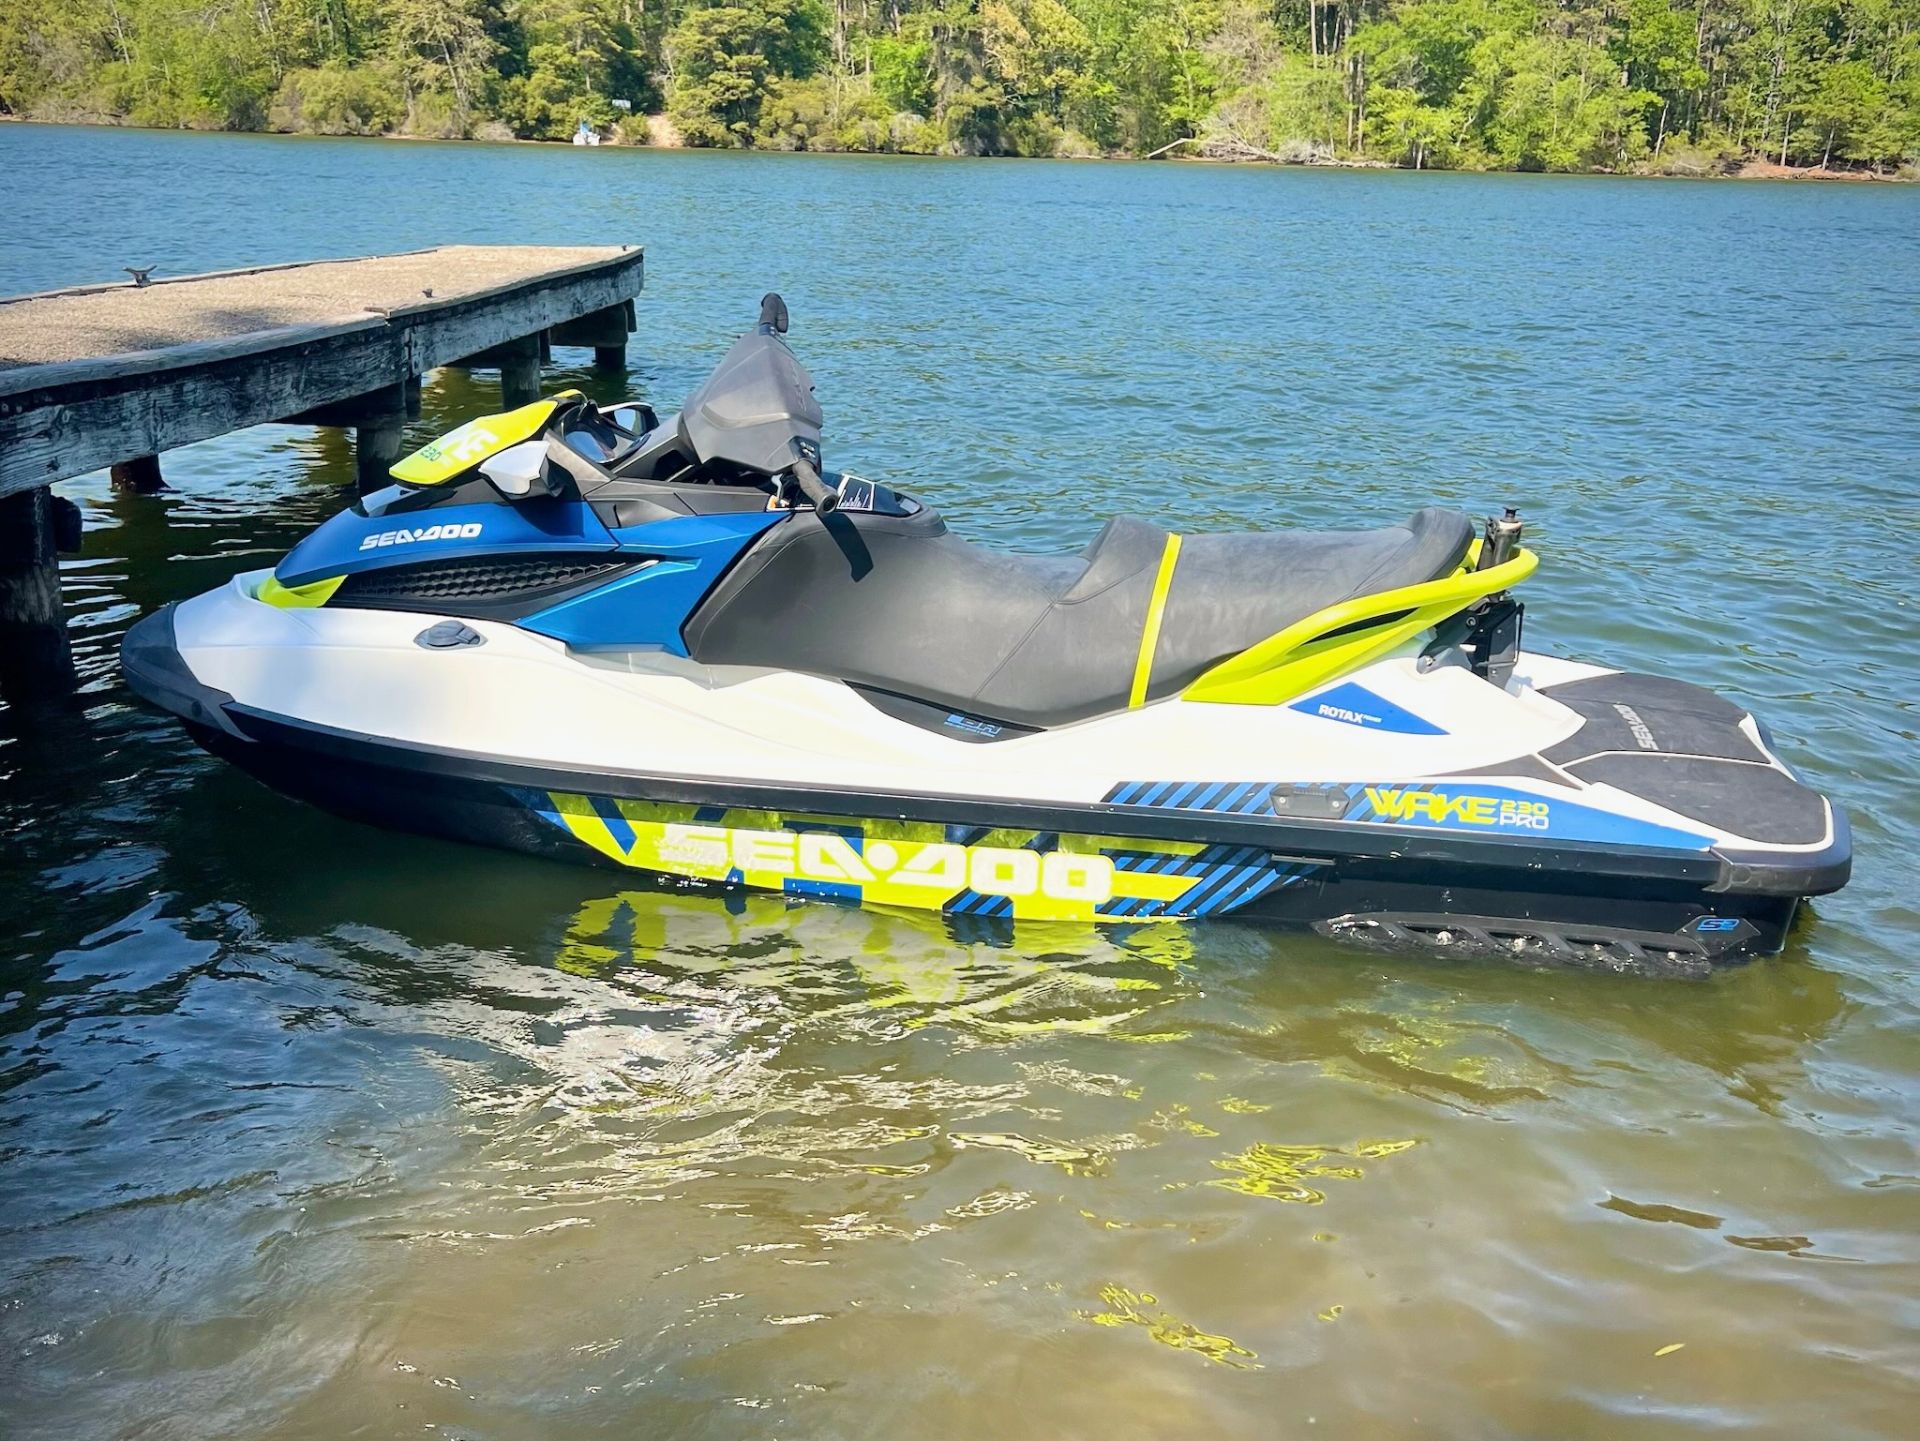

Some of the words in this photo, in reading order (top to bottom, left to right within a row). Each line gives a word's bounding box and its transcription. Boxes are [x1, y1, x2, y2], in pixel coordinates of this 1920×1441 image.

[1318, 703, 1363, 724] ROTAX
[1364, 788, 1500, 825] WAKE
[1500, 799, 1550, 816] 230
[1500, 813, 1550, 830] PRO
